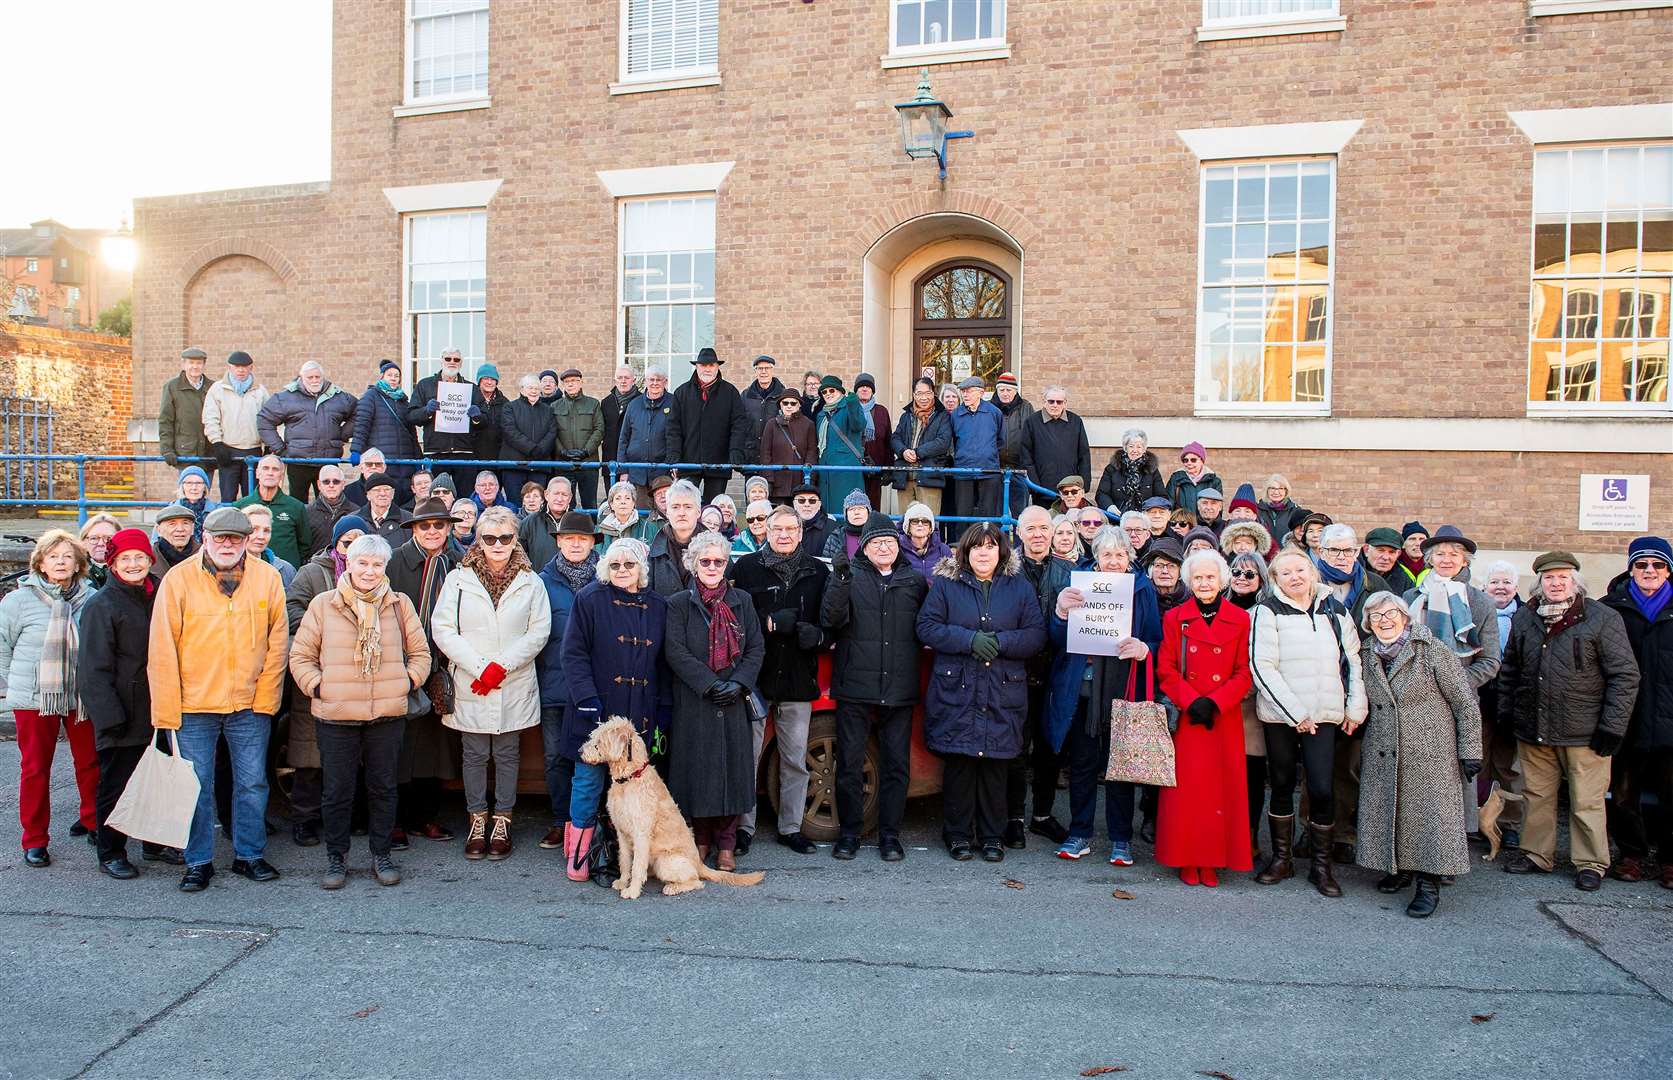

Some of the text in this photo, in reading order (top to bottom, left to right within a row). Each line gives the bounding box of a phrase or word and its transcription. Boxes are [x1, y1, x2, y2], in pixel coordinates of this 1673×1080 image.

[1092, 582, 1112, 592] SCC
[1108, 603, 1124, 611] OFF
[1085, 614, 1115, 624] BURY'S
[1078, 627, 1119, 637] ARCHIVES
